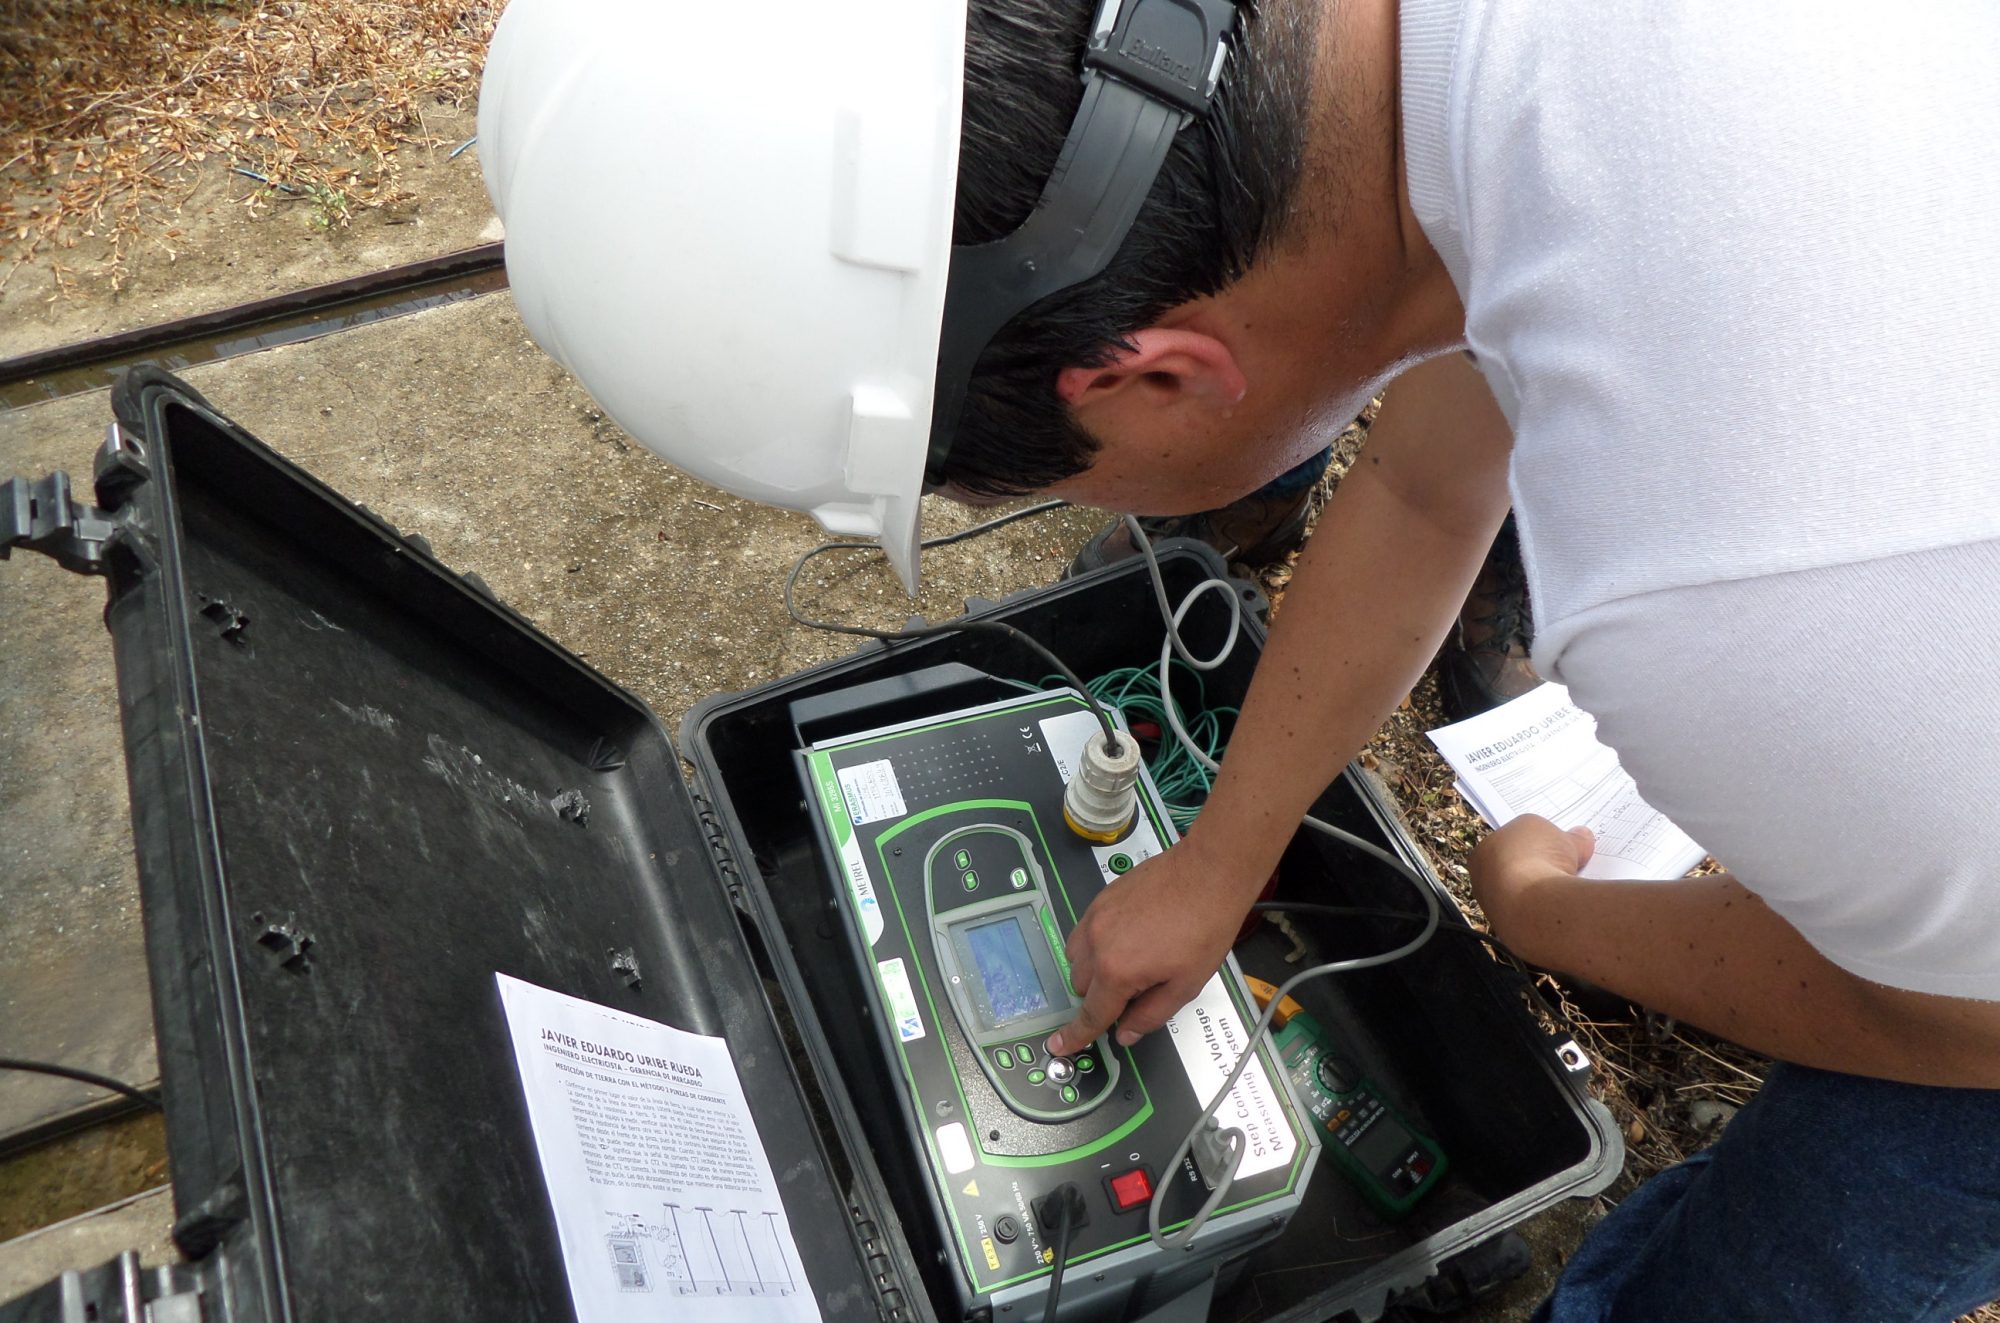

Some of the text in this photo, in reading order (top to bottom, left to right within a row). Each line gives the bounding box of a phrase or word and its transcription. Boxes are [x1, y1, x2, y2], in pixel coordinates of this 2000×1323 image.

[1465, 743, 1496, 764] JAVIER
[1494, 725, 1540, 753] EDUARDO
[1539, 707, 1571, 729] URIBE
[850, 860, 870, 896] METREL
[541, 1028, 703, 1079] JAVIER EDUARDO URIBE RUEDA
[1195, 1007, 1223, 1061] Voltage
[544, 1043, 580, 1060] INGENIERO
[581, 1055, 623, 1071] ELECTRICISTA
[629, 1066, 661, 1079] GERENCIA
[663, 1073, 671, 1081] DE
[672, 1075, 703, 1088] MERCADEO
[586, 1071, 594, 1079] DE
[594, 1074, 617, 1084] TIERRA
[1218, 1017, 1284, 1152] Measuring ystem
[1246, 1122, 1266, 1157] Step
[1034, 1250, 1044, 1264] 230
